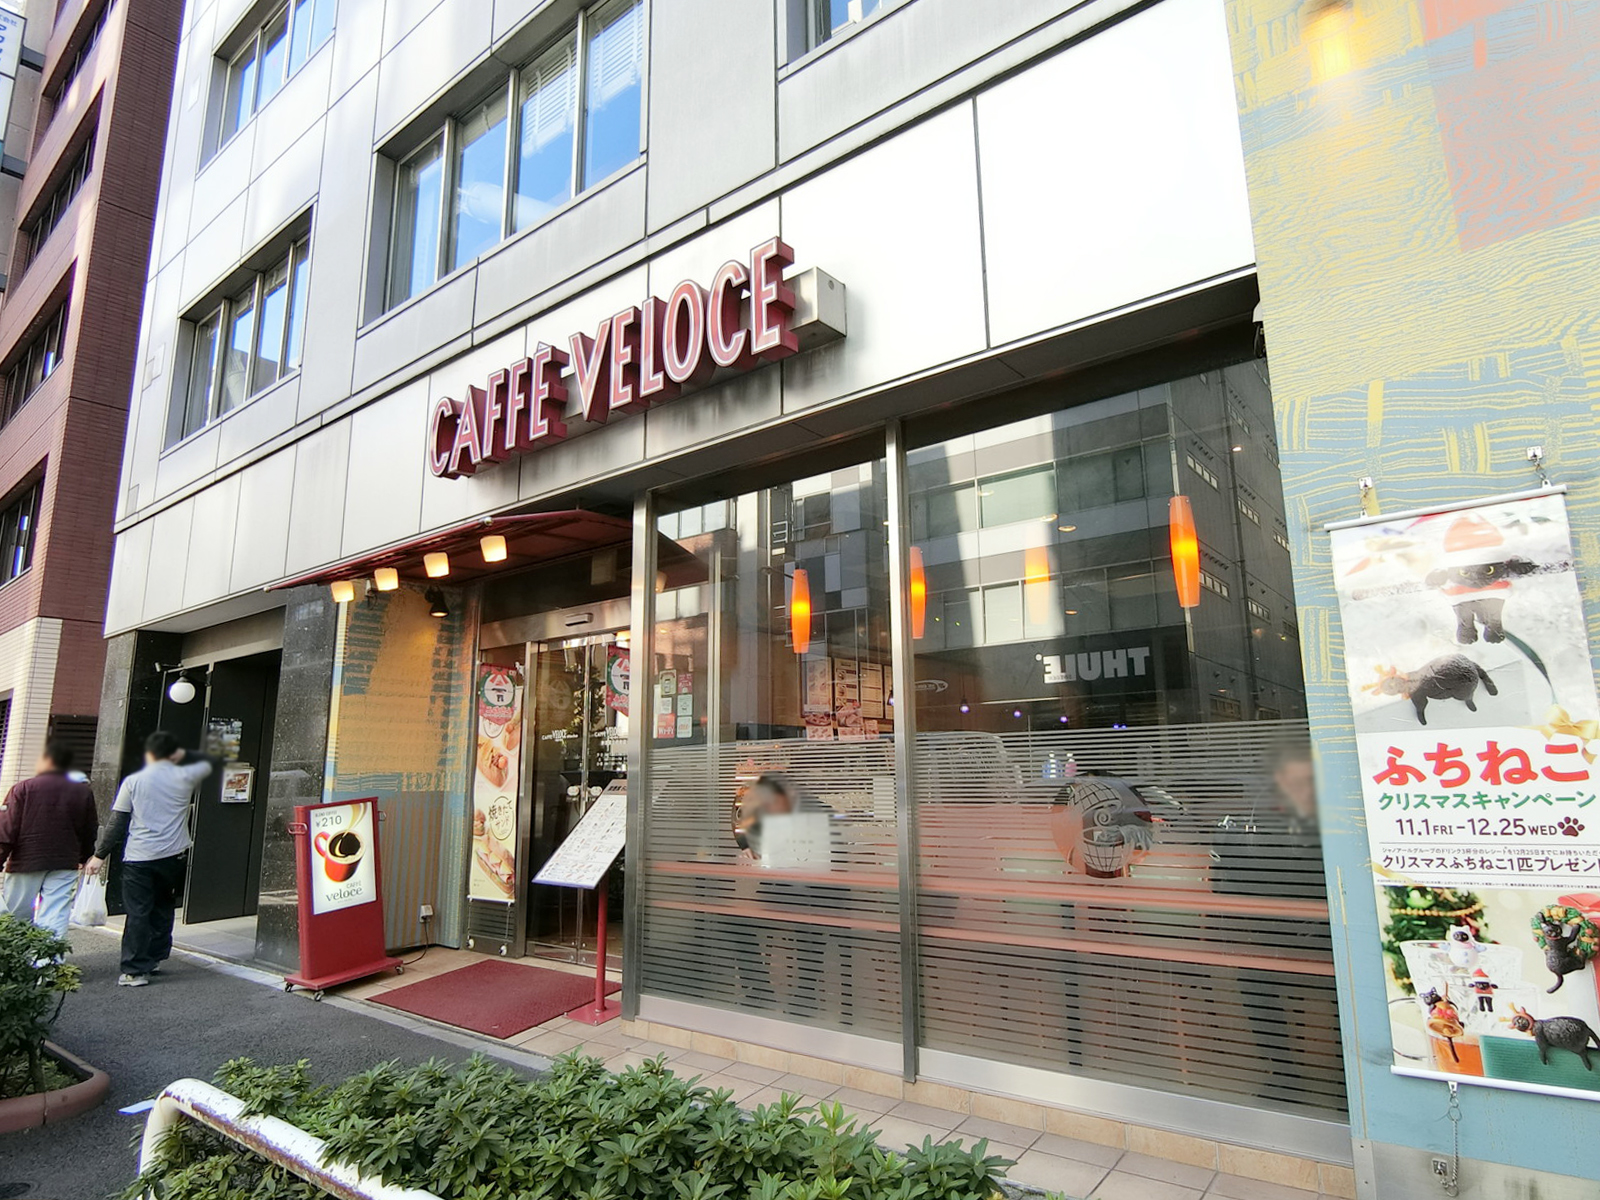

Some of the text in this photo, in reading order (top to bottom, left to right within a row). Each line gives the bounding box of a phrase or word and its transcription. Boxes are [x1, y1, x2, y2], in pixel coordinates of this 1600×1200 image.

[569, 236, 795, 422] VELOCE
[1372, 741, 1590, 788] ふちねこ
[1378, 790, 1597, 811] クリスマスキャンペーン
[325, 887, 364, 902] veloce
